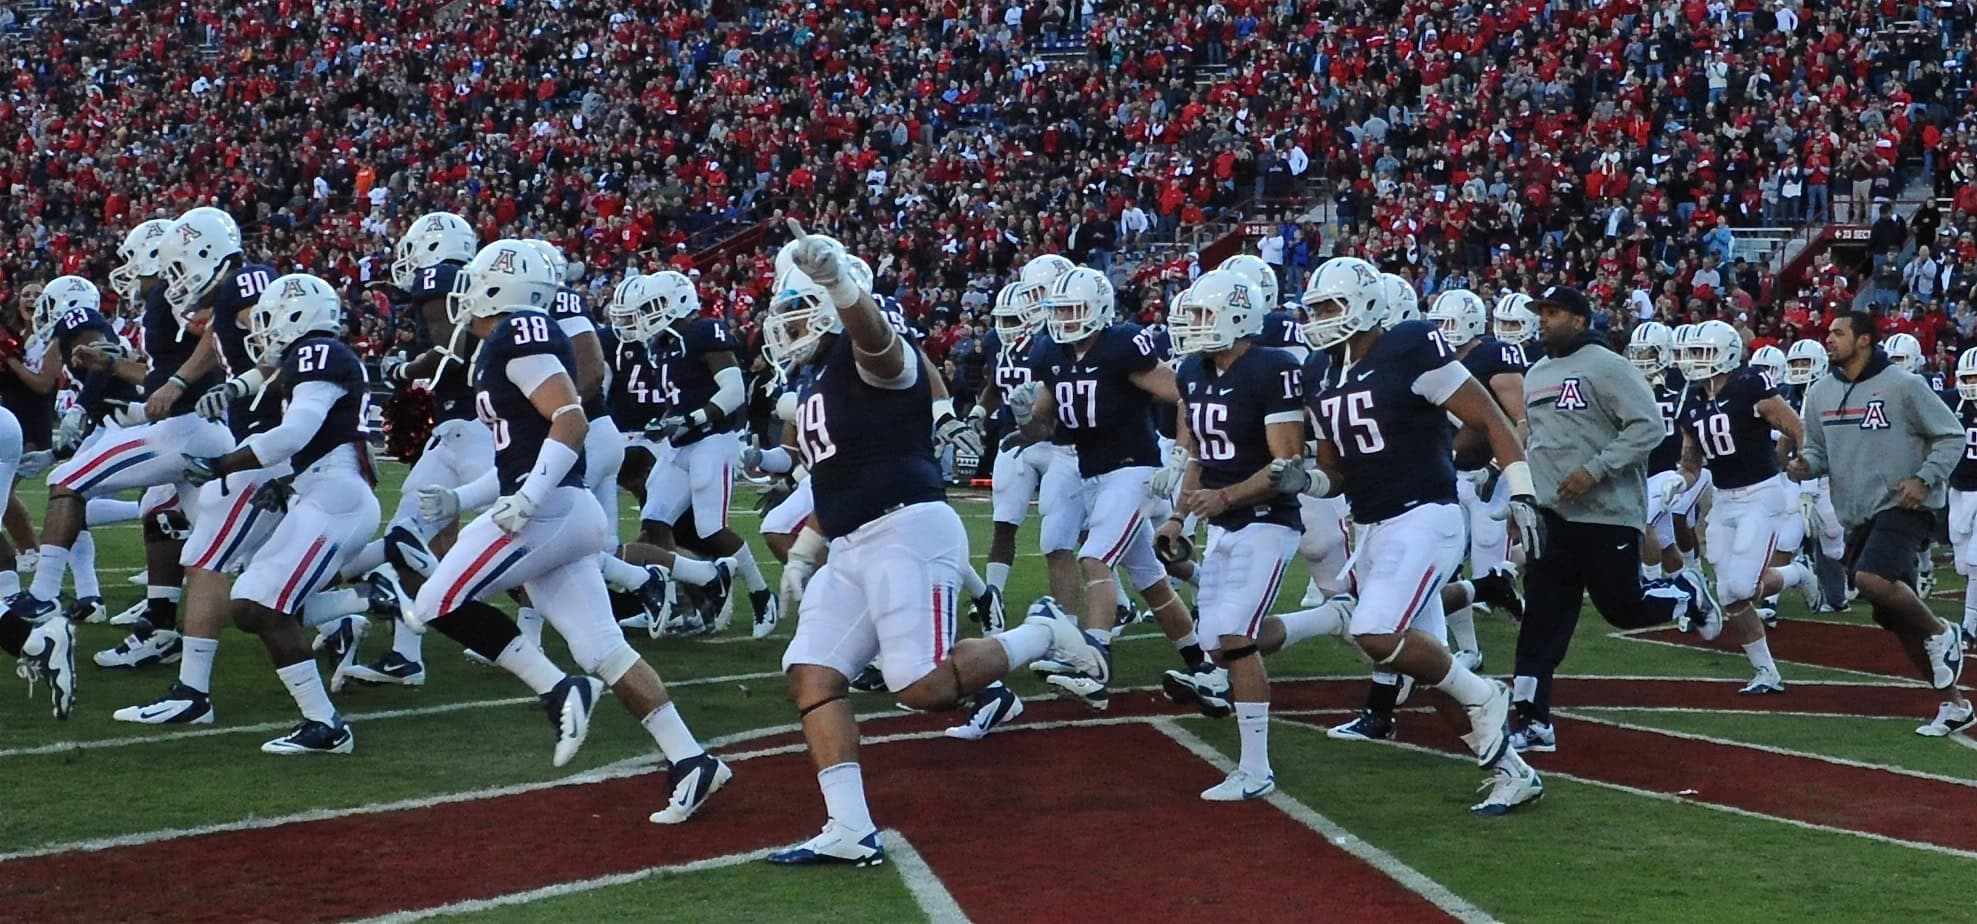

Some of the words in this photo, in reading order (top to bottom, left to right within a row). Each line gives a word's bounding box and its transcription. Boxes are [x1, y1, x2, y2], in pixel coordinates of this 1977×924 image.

[236, 270, 270, 299] 90
[423, 267, 438, 291] 2
[556, 291, 582, 314] 98
[63, 308, 89, 331] 23
[510, 315, 550, 346] 38
[298, 344, 331, 373] 27
[1280, 369, 1303, 400] 15
[1556, 378, 1588, 411] A
[1055, 379, 1099, 429] 87
[1860, 400, 1891, 431] A
[1189, 402, 1236, 460] 15
[1320, 390, 1385, 458] 75
[1692, 413, 1737, 460] 18
